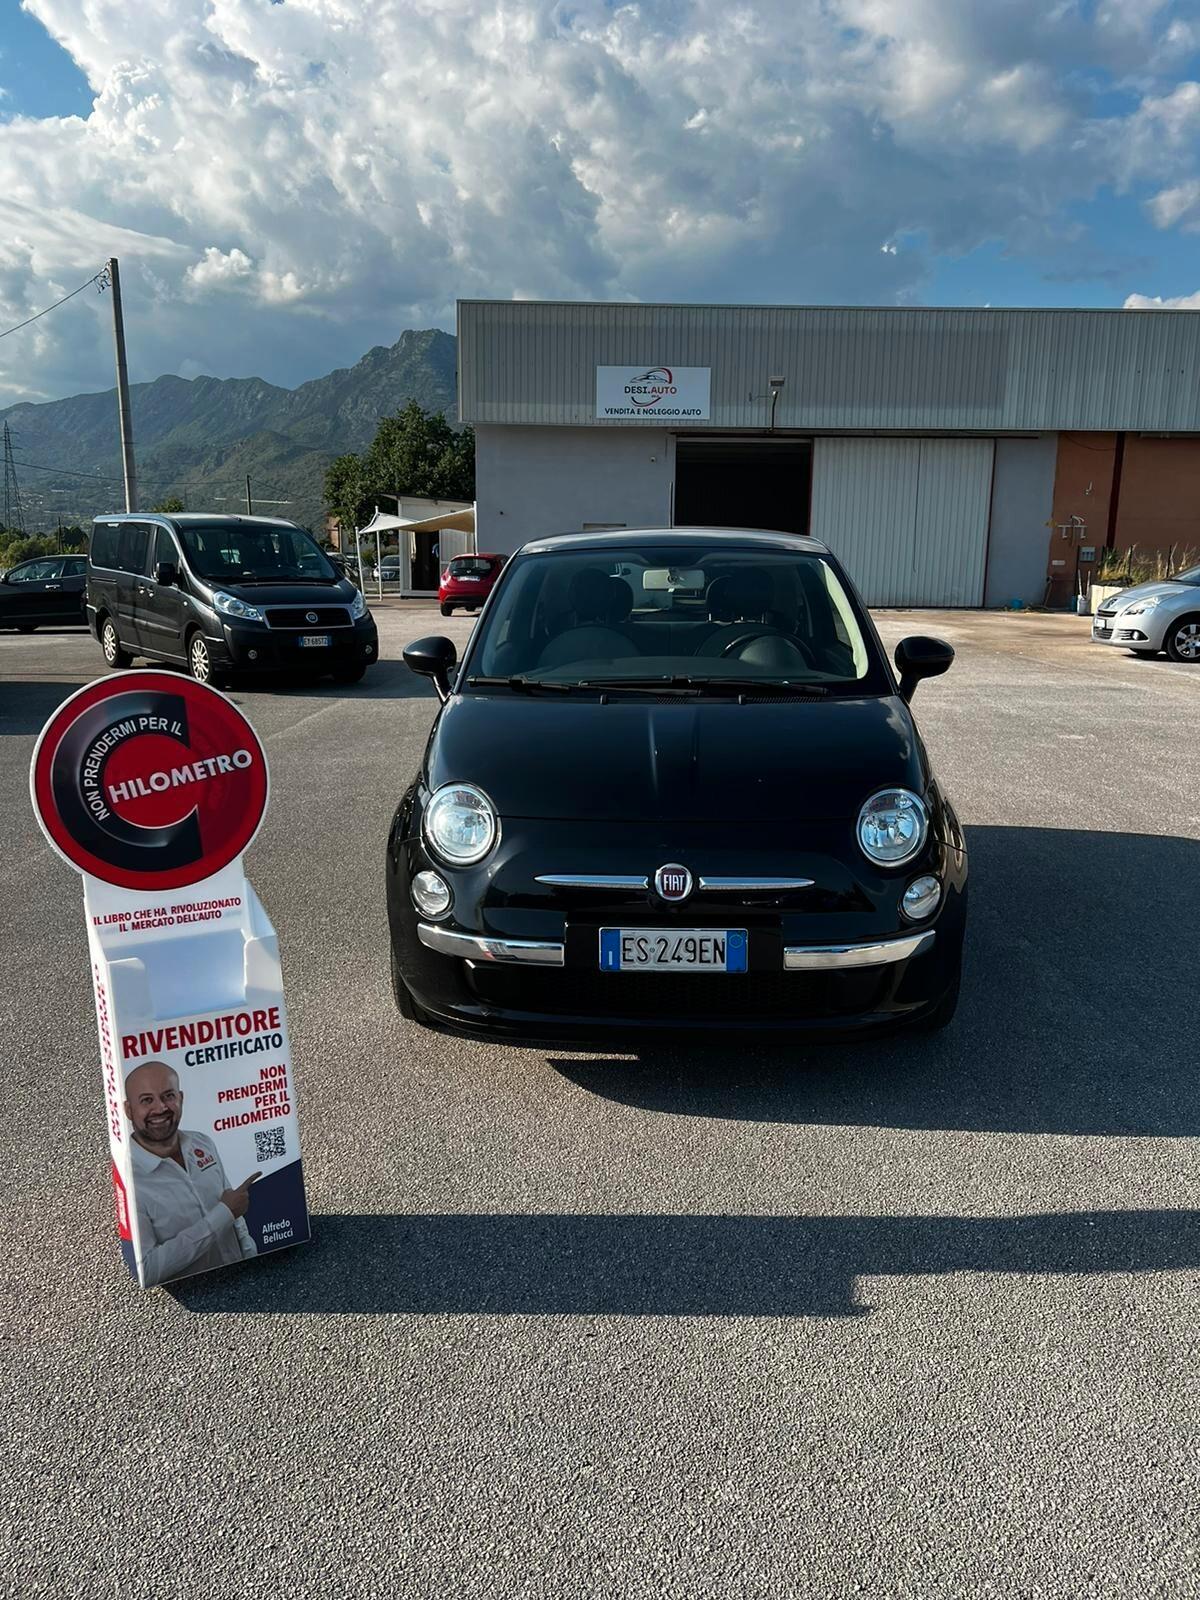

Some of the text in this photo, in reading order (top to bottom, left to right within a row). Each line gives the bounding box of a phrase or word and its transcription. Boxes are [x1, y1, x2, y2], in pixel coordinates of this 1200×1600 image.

[624, 386, 677, 395] DESI.AUTO
[84, 717, 183, 821] NON PRENDERMI PER IL
[663, 874, 685, 891] FIAT
[93, 897, 242, 926] IL LIBRO CHE HA RIVOLUZIONATO
[119, 910, 222, 932] IL MERCATO DELL'AUTO
[122, 1006, 281, 1059] RIVENDITORE
[185, 1033, 283, 1067] CERTIFICATO
[259, 1064, 286, 1081] NON
[218, 1077, 288, 1103] PRENDERMI
[255, 1090, 291, 1109] PER IL
[214, 1103, 291, 1132] CHILOMETRO
[262, 1219, 291, 1234] Alfredo
[263, 1228, 294, 1244] Bellucci
